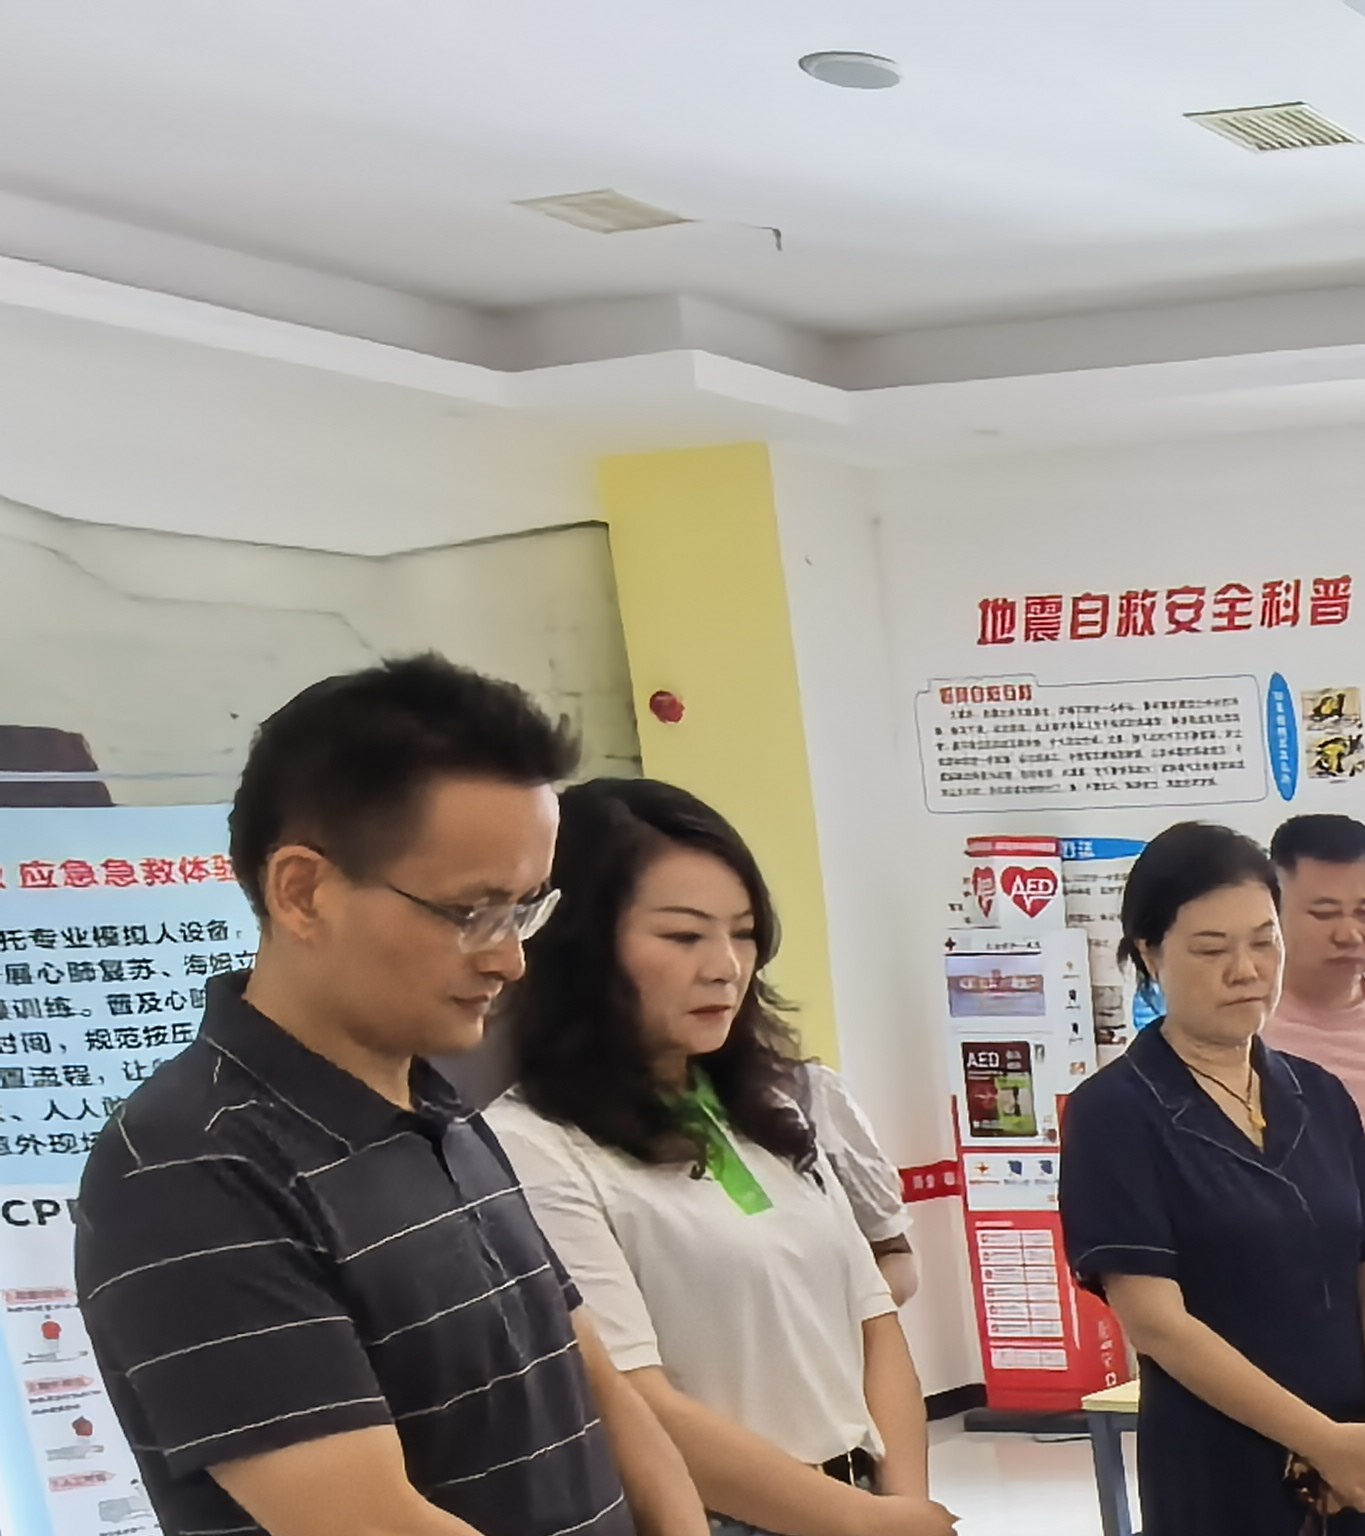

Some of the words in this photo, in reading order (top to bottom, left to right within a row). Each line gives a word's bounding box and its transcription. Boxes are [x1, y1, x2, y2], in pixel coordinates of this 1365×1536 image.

[976, 574, 1353, 646] 地震自救安全科普
[968, 1052, 999, 1068] AED
